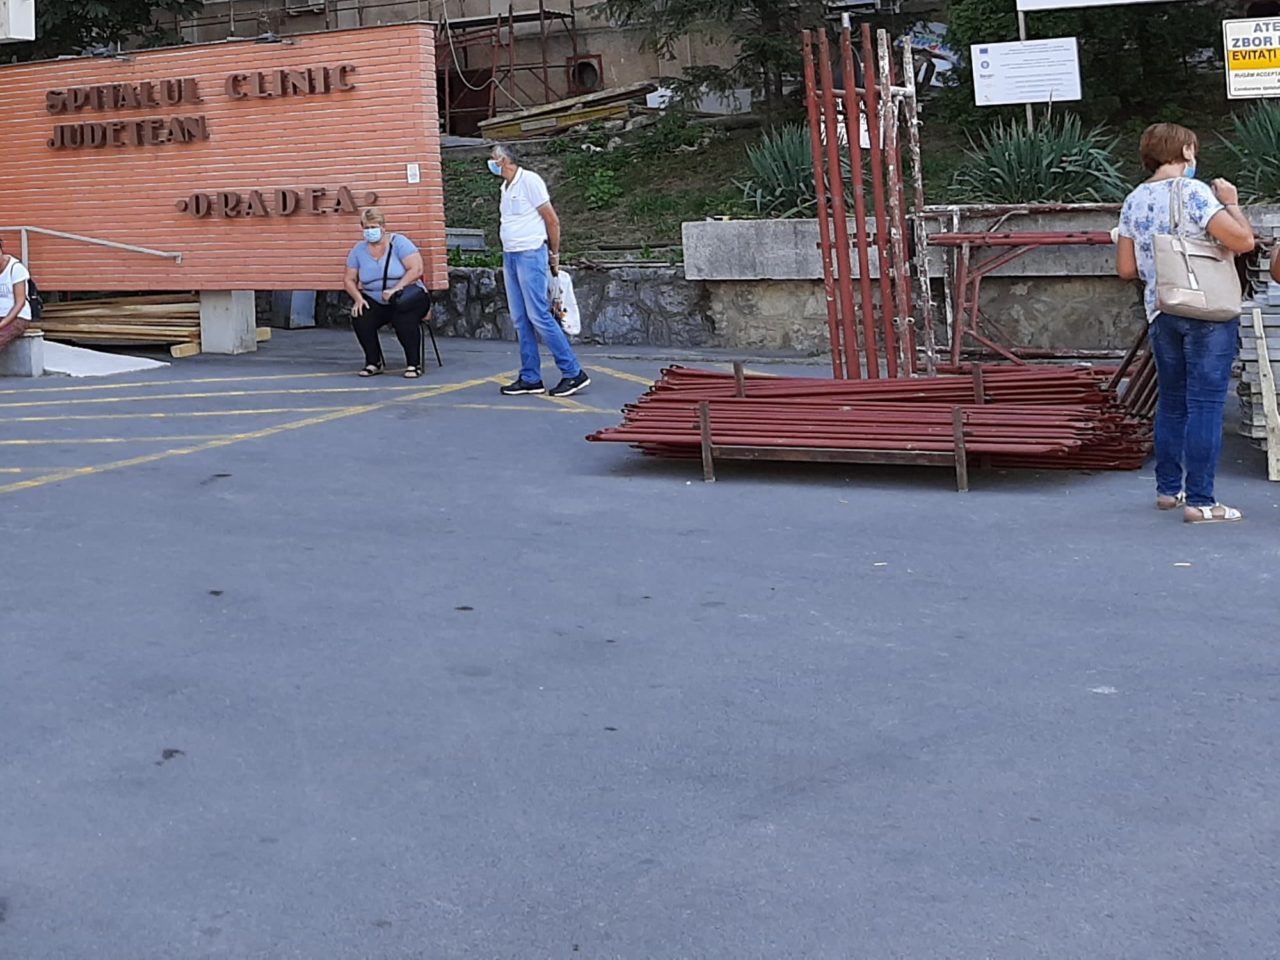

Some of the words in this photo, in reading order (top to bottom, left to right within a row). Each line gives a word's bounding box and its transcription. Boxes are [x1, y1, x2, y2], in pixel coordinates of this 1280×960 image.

[1231, 36, 1273, 48] ZBOR
[46, 77, 204, 115] SPITALUL
[225, 63, 356, 100] CLINIC
[47, 116, 210, 150] JUDETEAN
[187, 185, 358, 219] ORADEA
